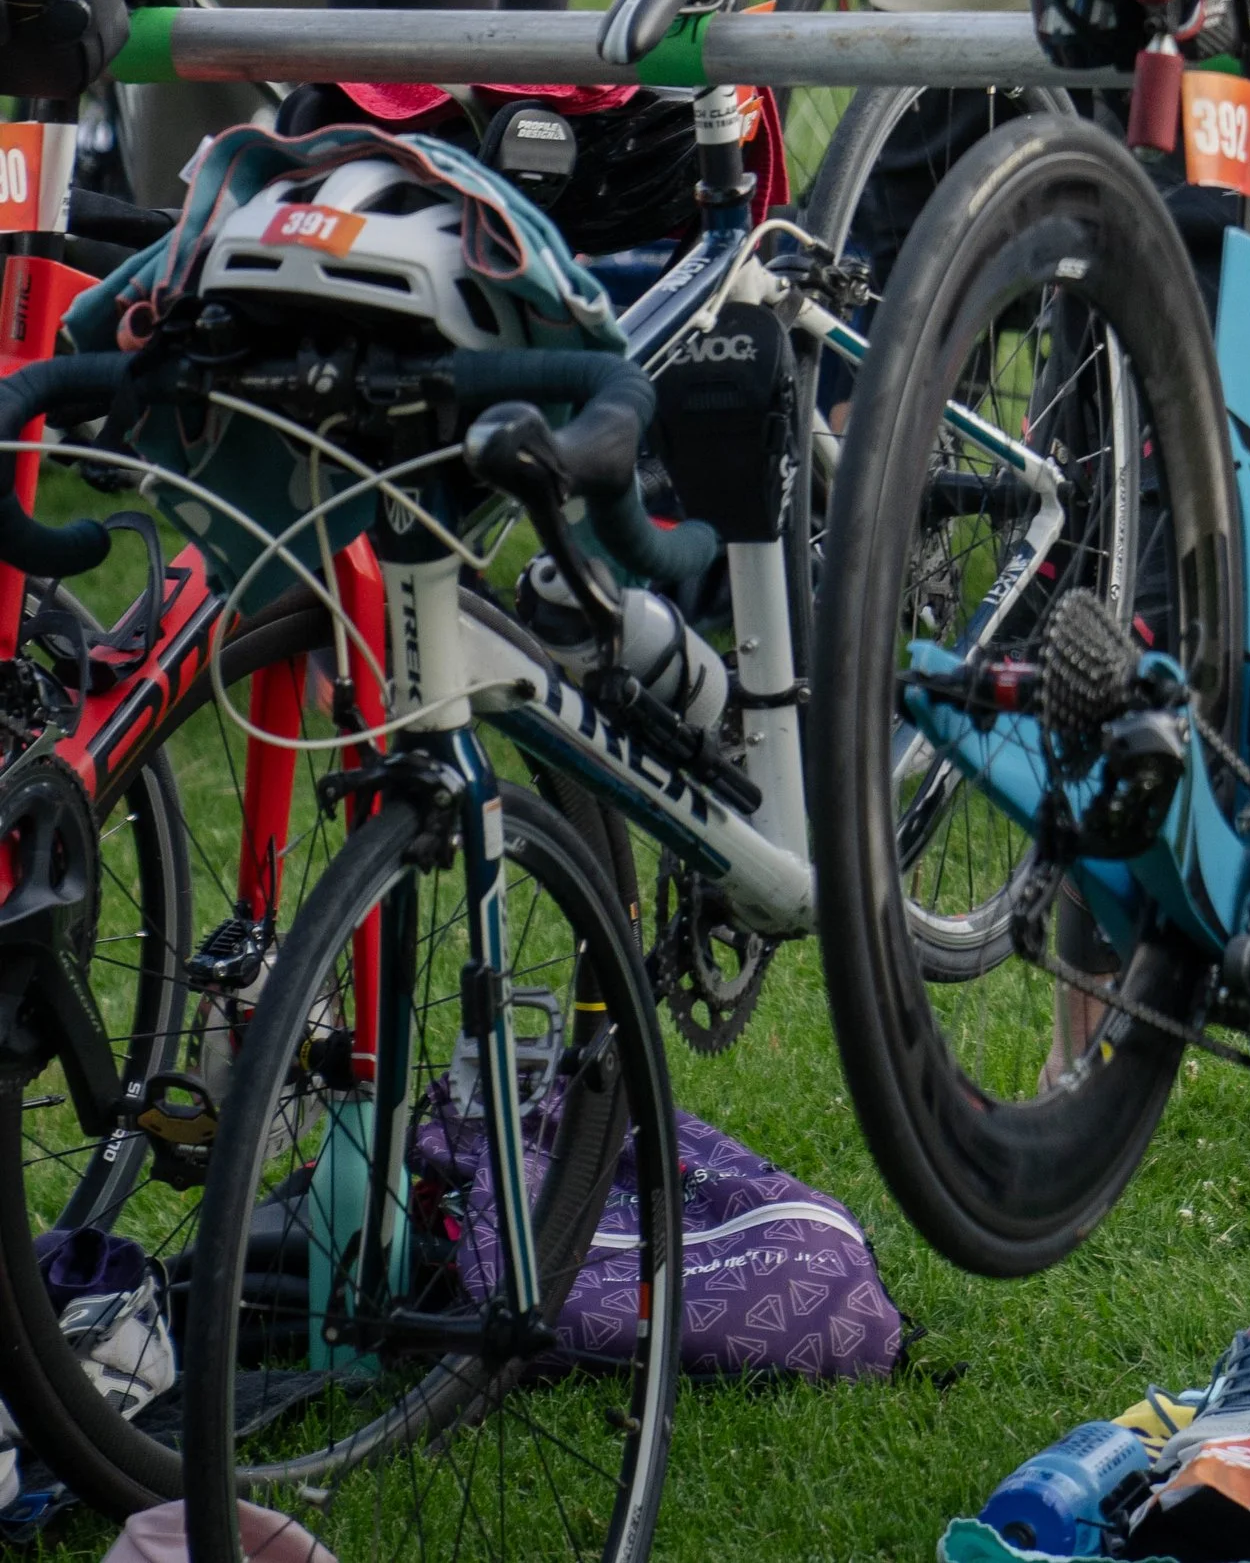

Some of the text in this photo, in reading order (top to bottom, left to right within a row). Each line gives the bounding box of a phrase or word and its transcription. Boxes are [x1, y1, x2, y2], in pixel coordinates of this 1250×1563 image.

[1191, 98, 1249, 163] 392
[281, 209, 340, 240] 391
[400, 573, 423, 705] TREK
